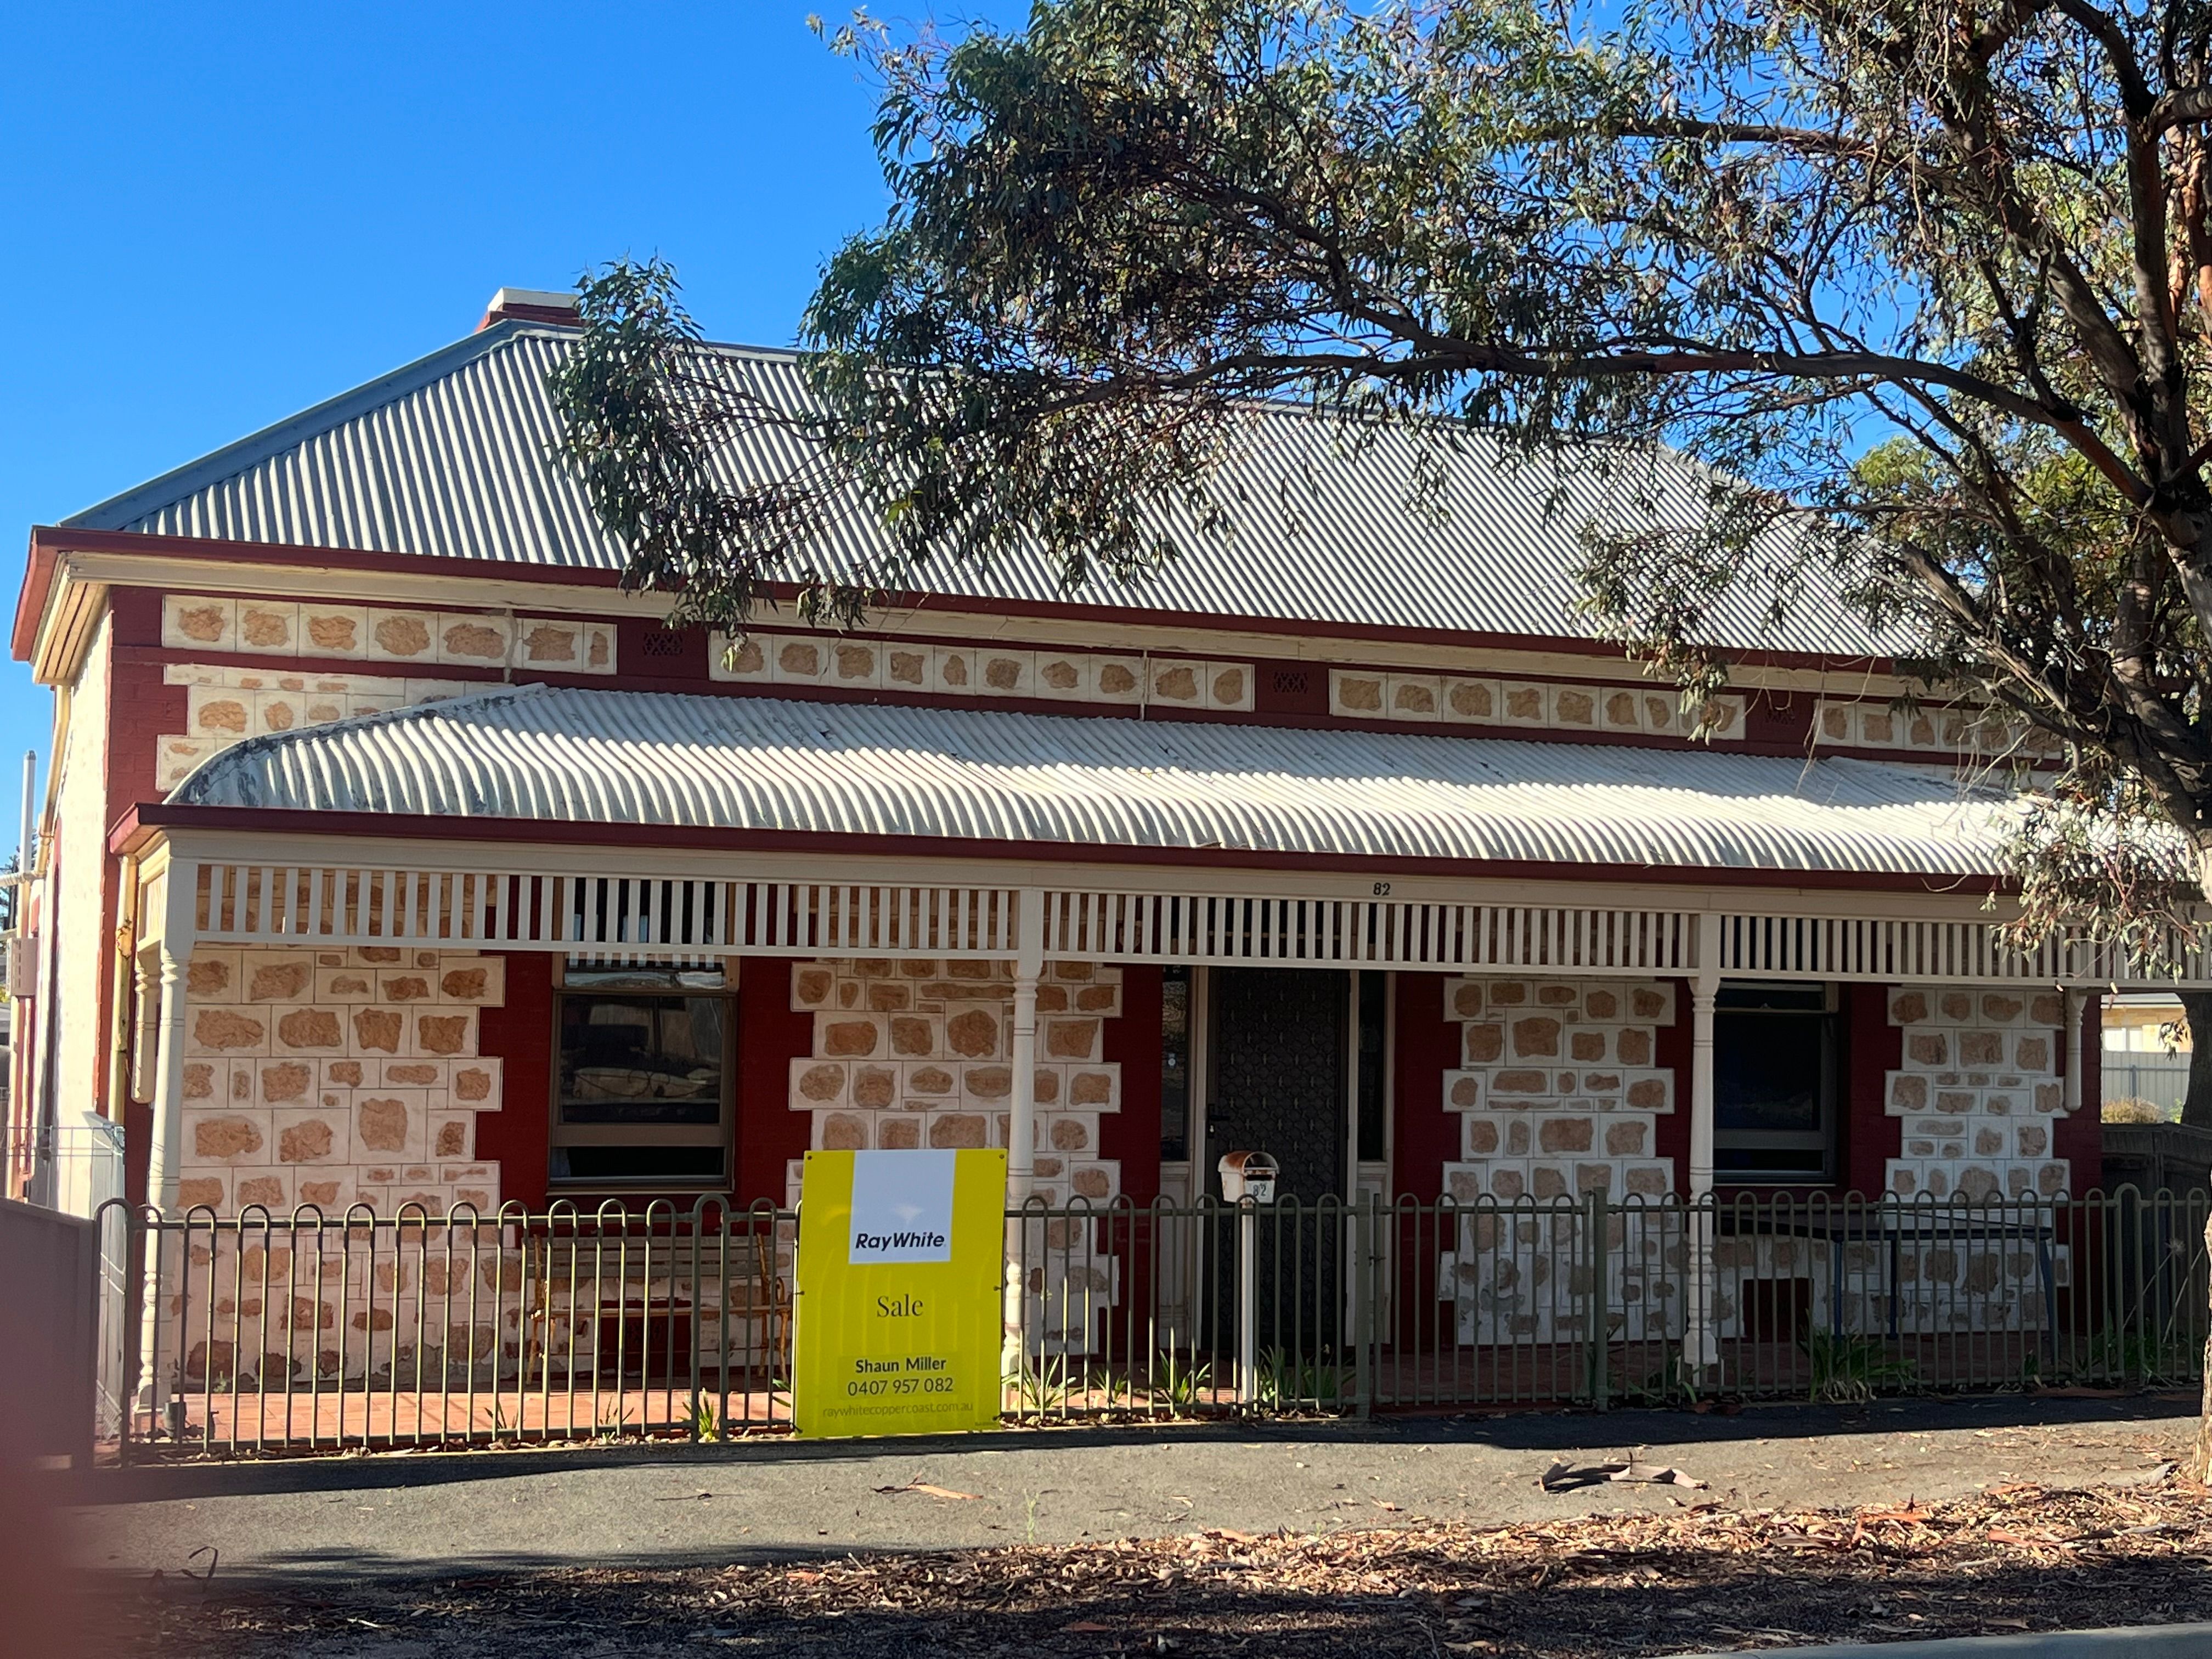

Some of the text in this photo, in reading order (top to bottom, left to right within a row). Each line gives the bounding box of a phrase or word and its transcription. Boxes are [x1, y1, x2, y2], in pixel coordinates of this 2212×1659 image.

[1373, 882, 1391, 896] 82
[1253, 1183, 1267, 1197] 82
[877, 1293, 923, 1318] Sale
[855, 1356, 947, 1374] Shaun Miller
[848, 1377, 953, 1397] 0407 957 082
[823, 1401, 973, 1419] raywhitecoppercoast.com.au
